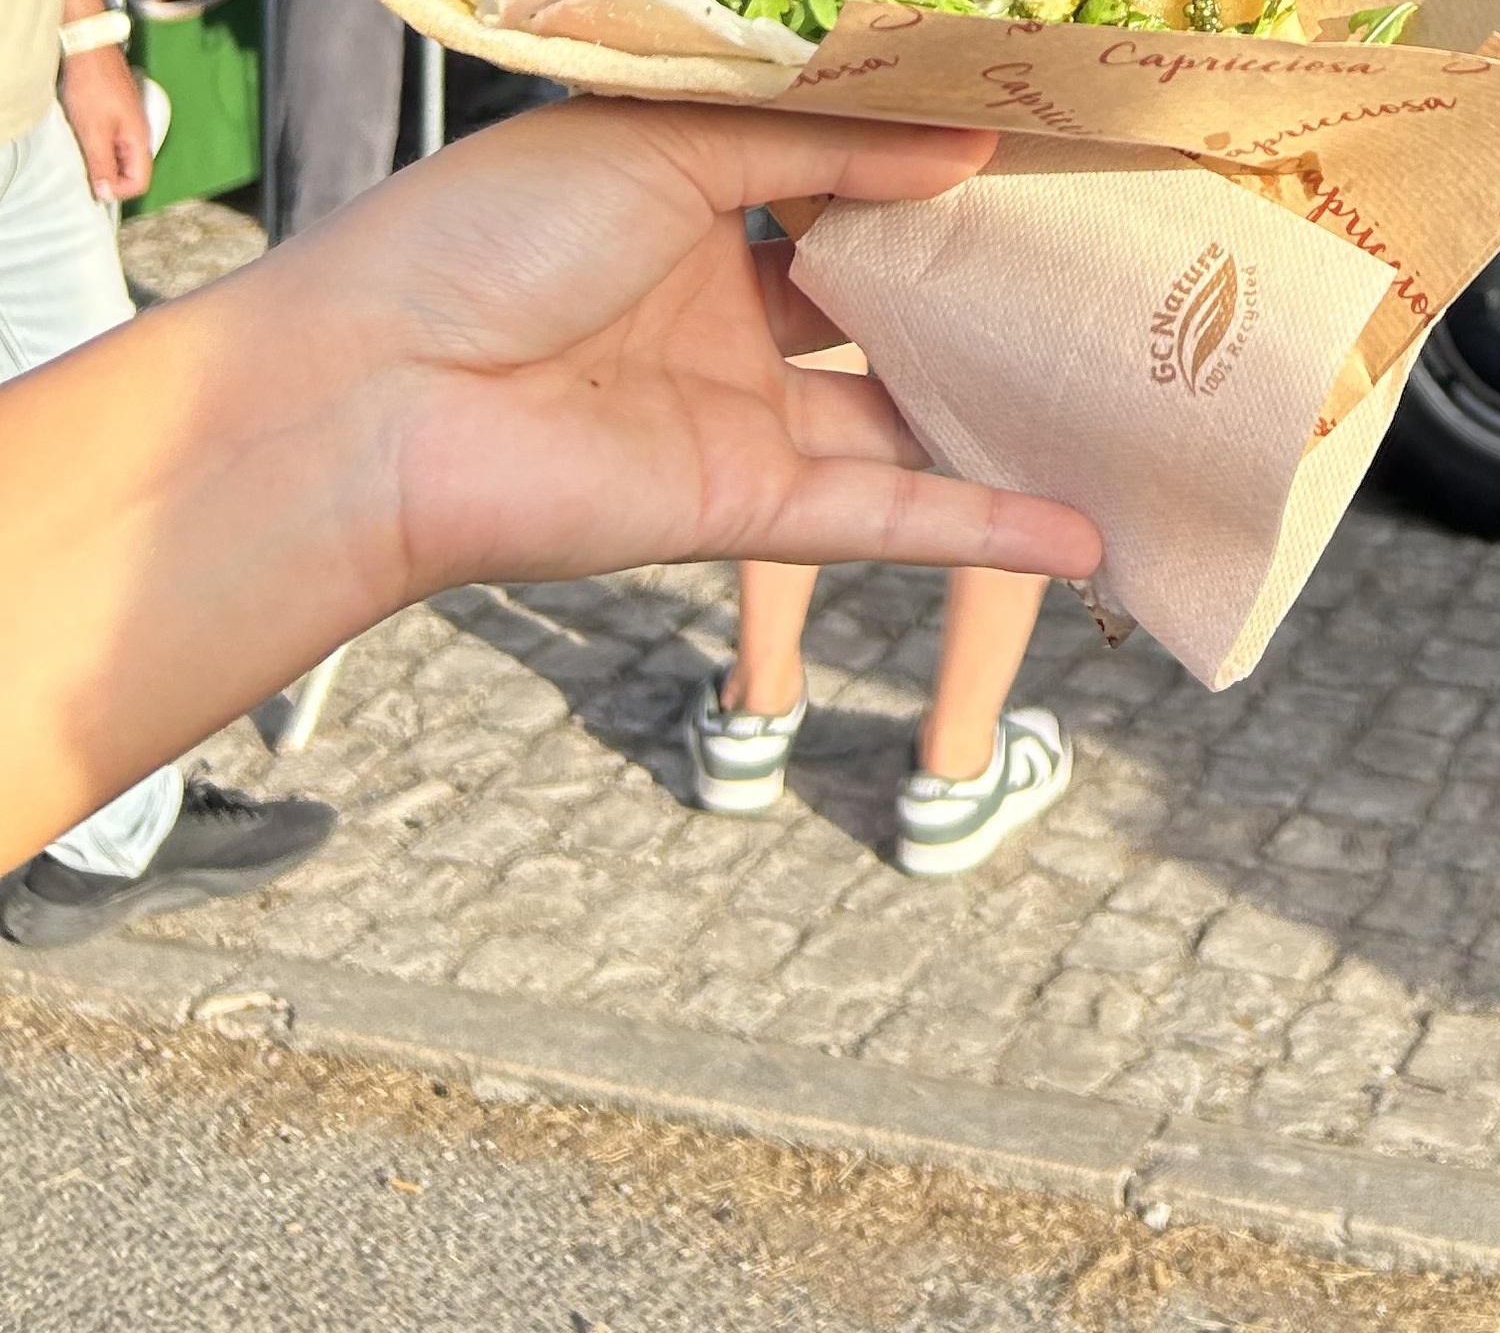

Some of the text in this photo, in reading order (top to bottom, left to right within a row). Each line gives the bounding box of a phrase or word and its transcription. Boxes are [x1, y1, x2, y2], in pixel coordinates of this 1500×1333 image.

[1100, 40, 1386, 84] Capricciosa
[1225, 96, 1457, 157] apricciosa
[1200, 263, 1259, 397] 100% Recycled
